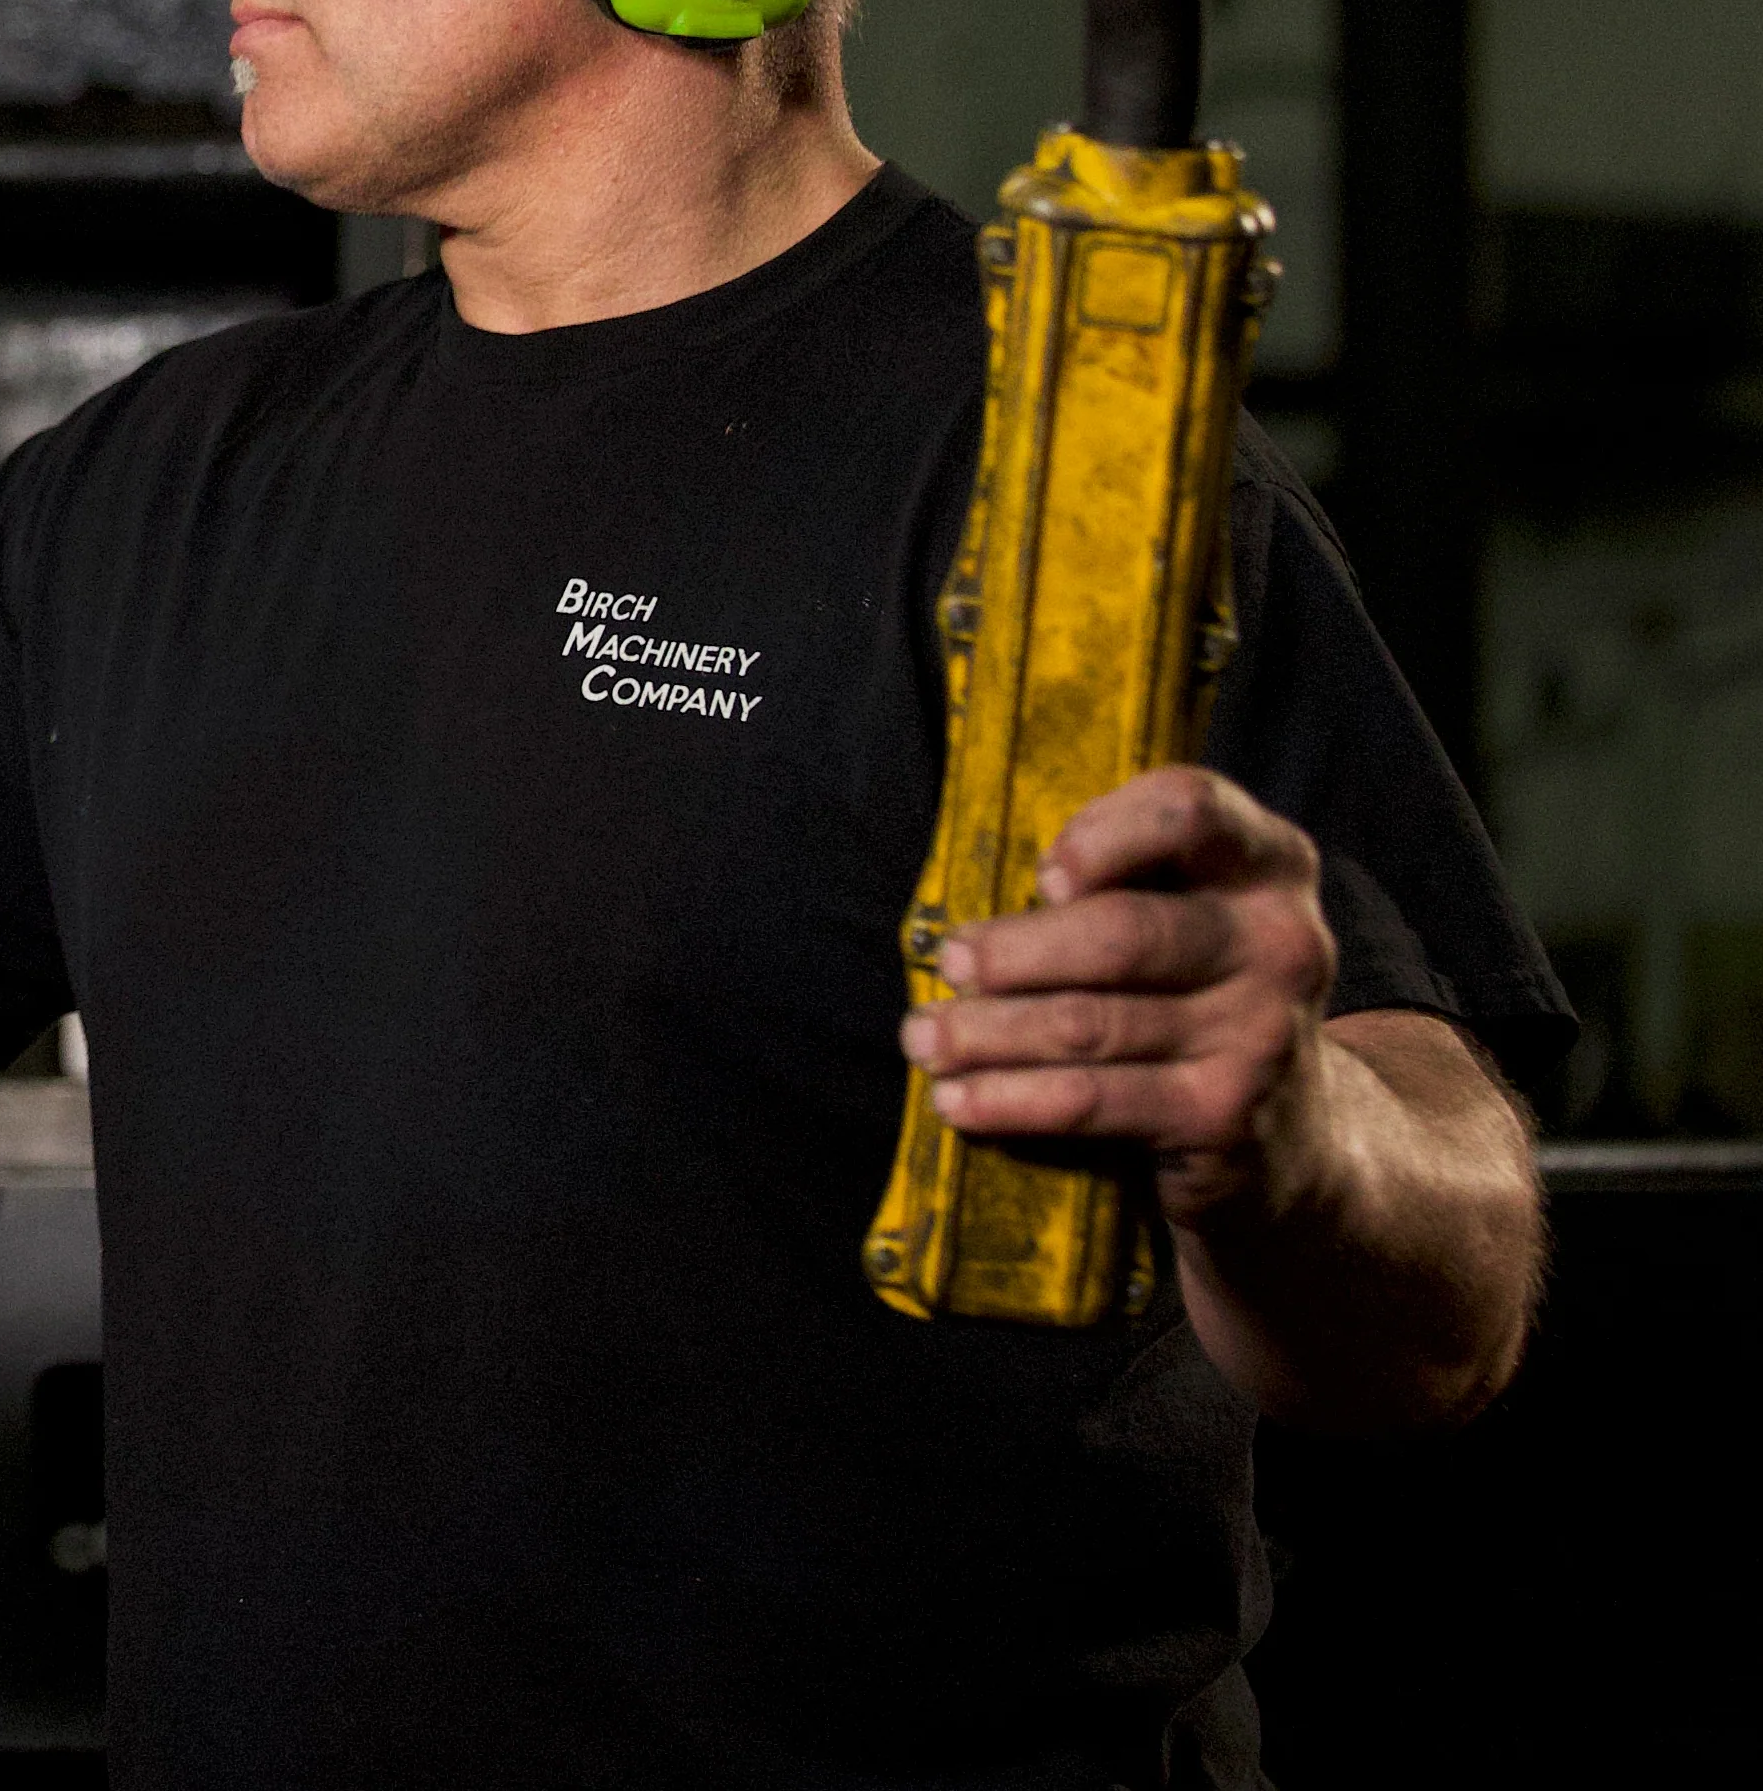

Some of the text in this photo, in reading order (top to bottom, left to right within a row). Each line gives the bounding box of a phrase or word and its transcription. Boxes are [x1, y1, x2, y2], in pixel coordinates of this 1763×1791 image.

[555, 577, 658, 622] BIRCH
[561, 621, 761, 676] MACHINERY
[580, 665, 763, 722] COMPANY
